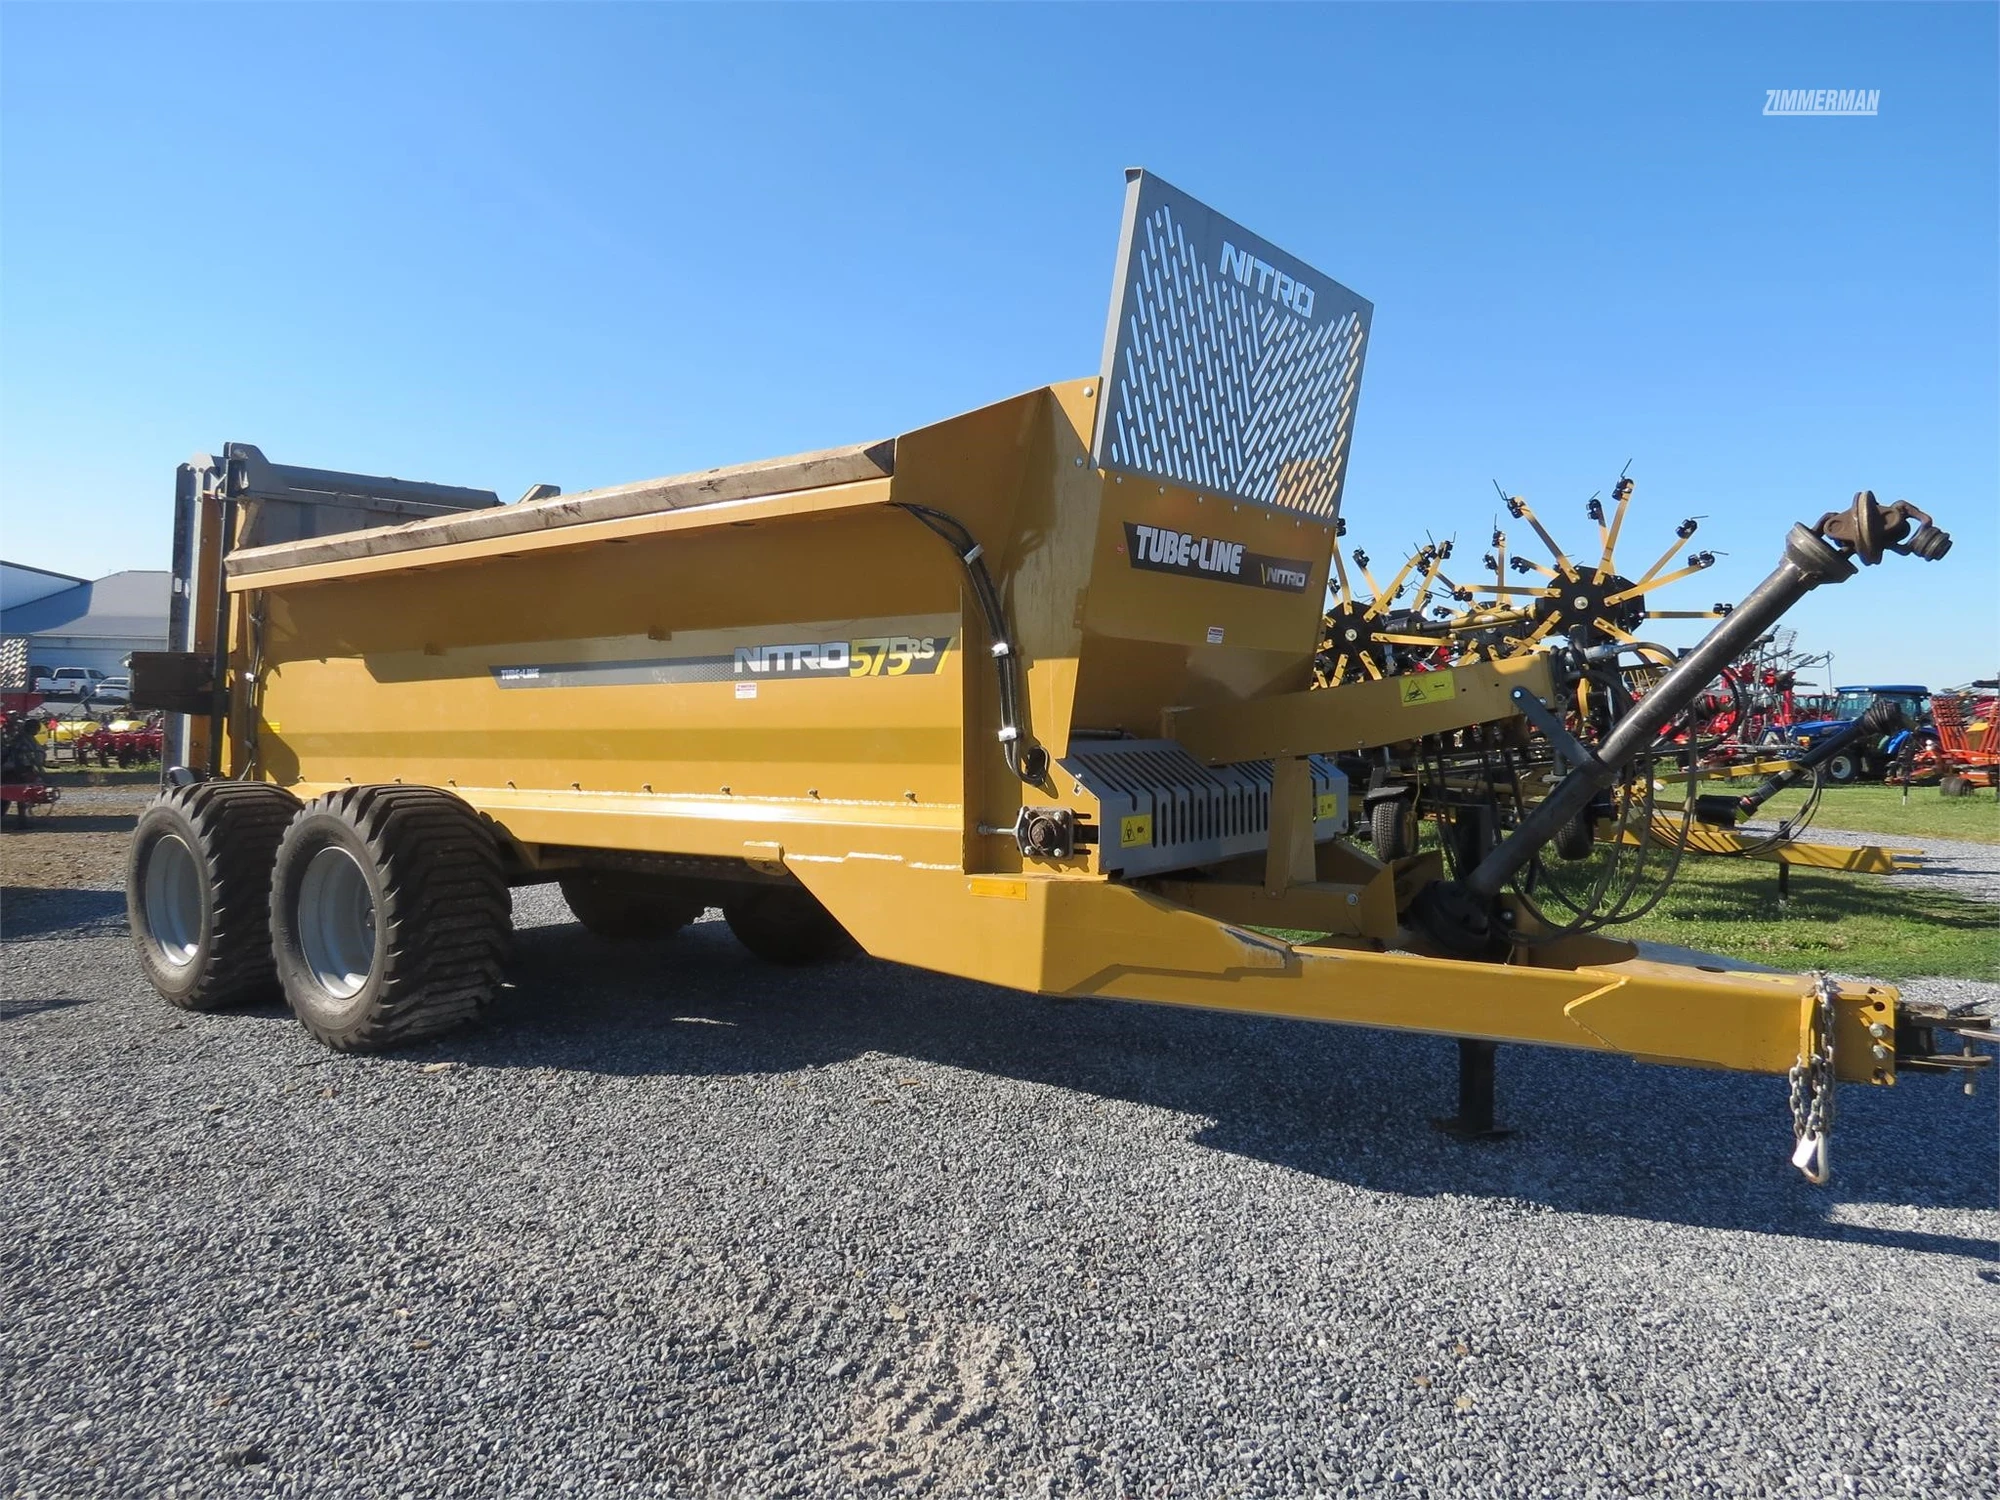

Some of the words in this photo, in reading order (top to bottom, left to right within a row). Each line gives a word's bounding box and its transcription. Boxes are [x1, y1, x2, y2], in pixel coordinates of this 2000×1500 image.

[1219, 241, 1315, 318] NITRO
[1266, 567, 1306, 587] NITRO
[734, 641, 850, 674] NITRO
